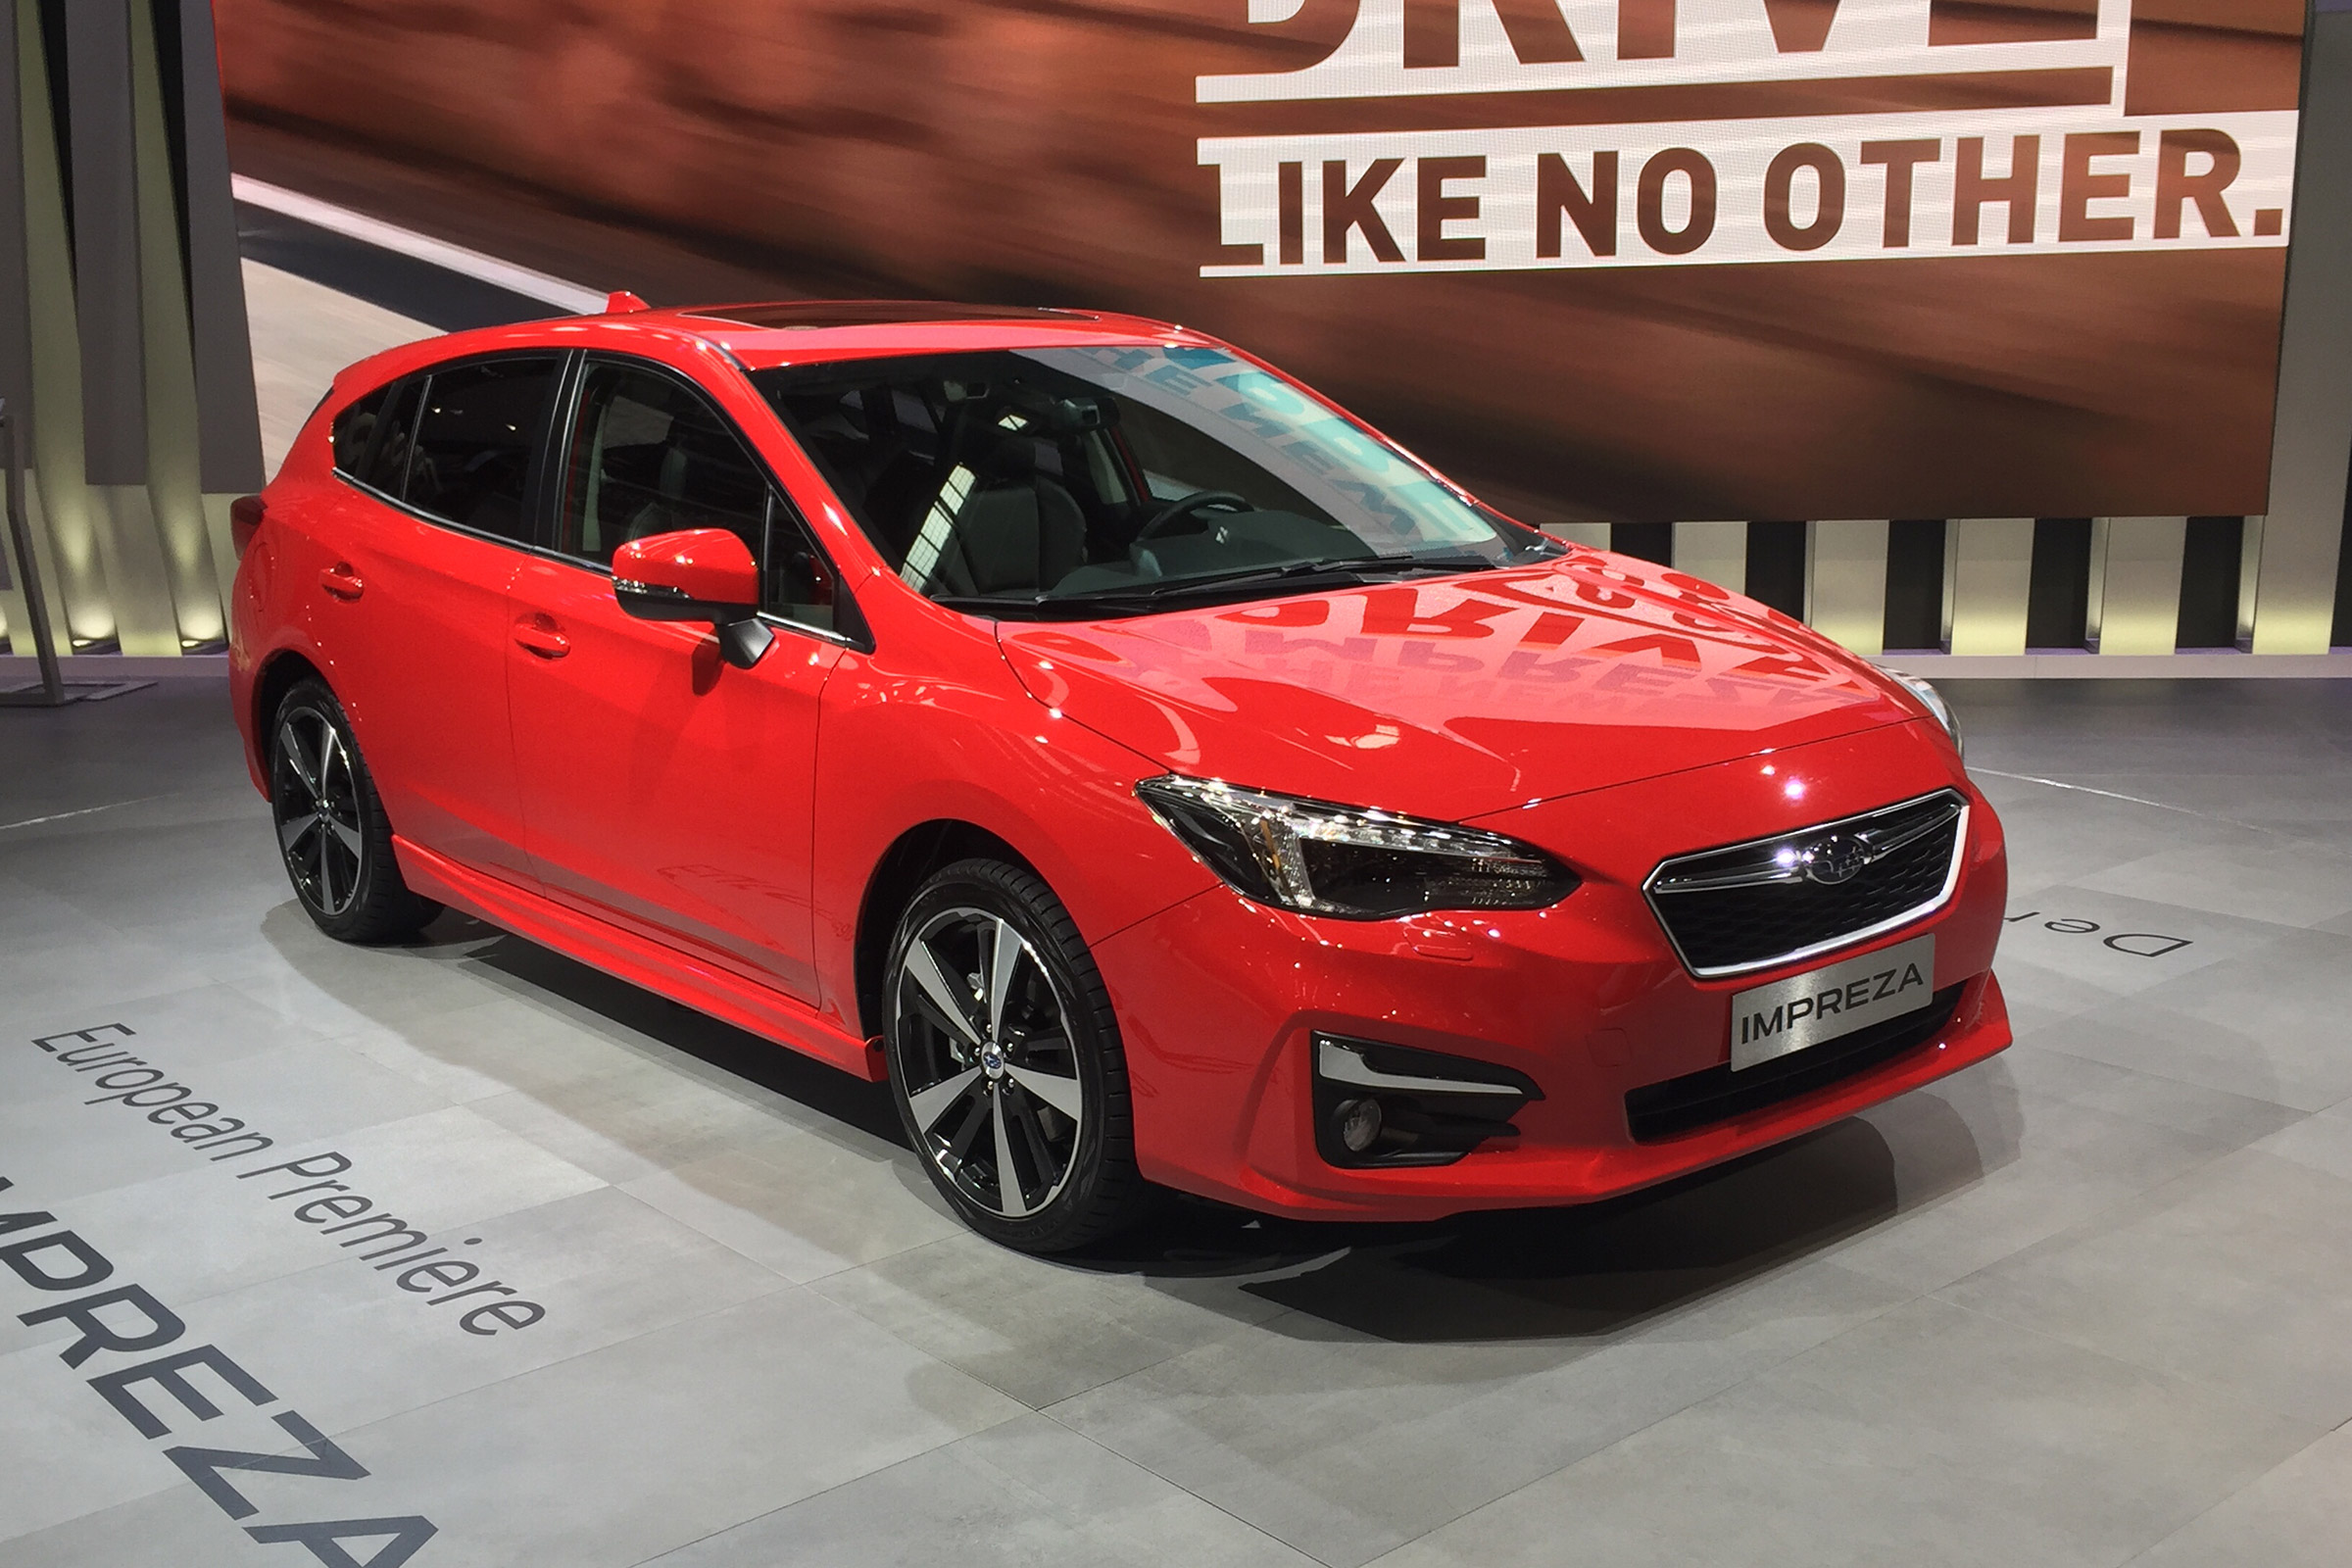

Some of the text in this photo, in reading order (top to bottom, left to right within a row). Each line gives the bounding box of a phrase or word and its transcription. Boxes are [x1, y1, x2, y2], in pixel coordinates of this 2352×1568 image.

[1198, 127, 2283, 267] LIKE NO OTHER.
[1741, 962, 1924, 1045] IMPREZA
[30, 1022, 547, 1337] European Premiere
